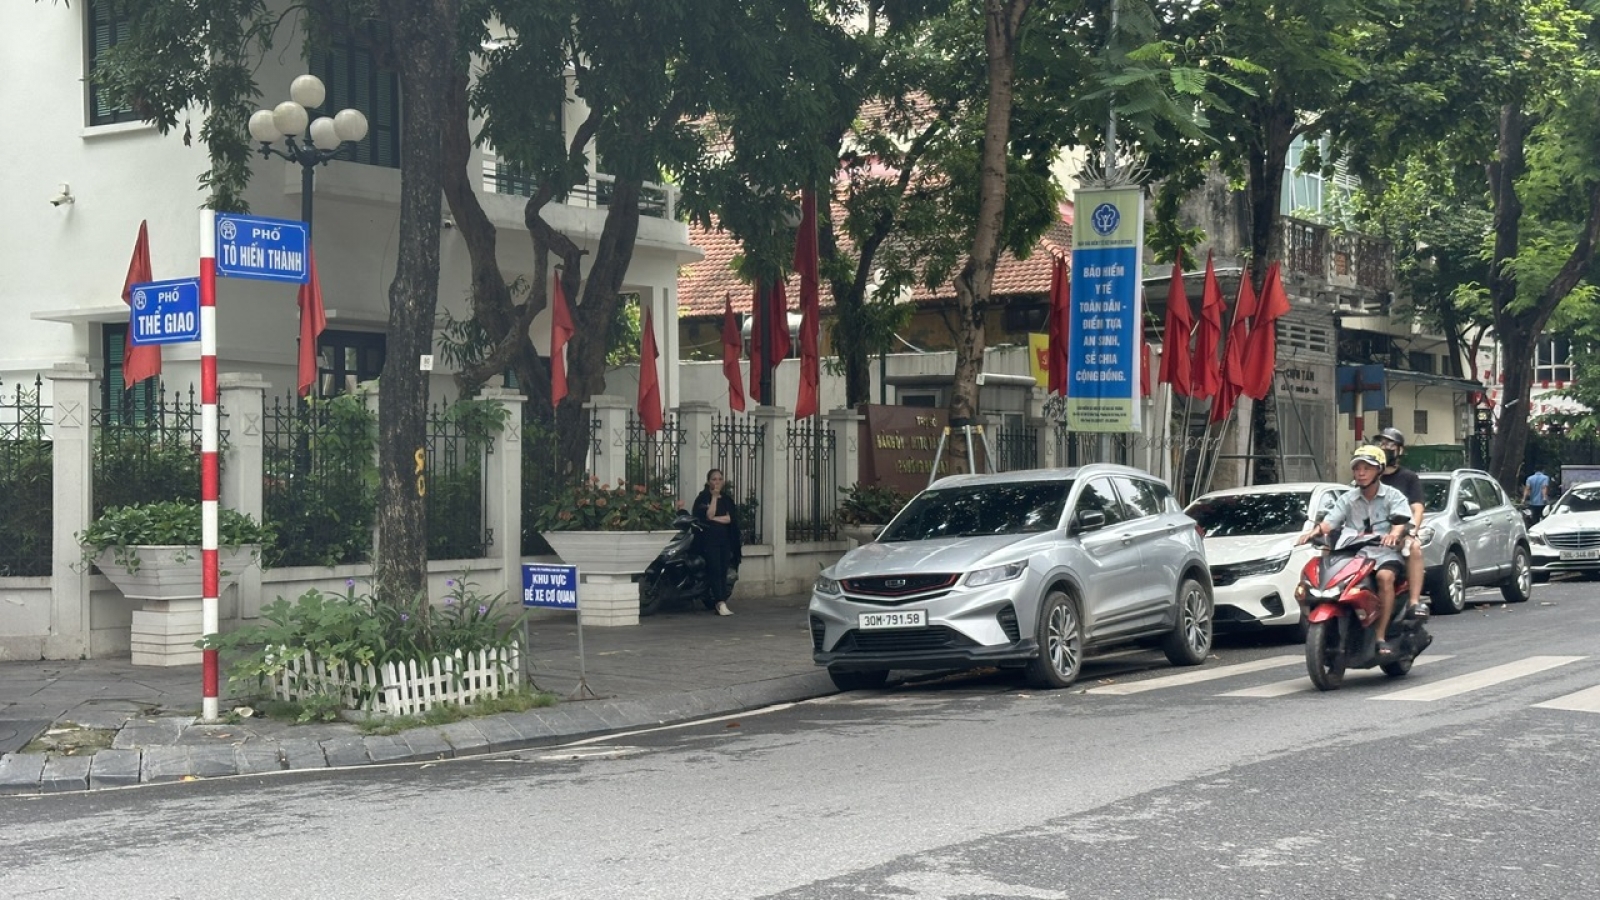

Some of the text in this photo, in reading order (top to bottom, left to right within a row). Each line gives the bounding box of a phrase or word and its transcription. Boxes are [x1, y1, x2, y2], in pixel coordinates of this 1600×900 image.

[252, 227, 281, 241] PHỐ
[223, 241, 302, 271] TÔ HIẾN THÀNH
[158, 286, 180, 303] PHỐ
[1094, 280, 1113, 295] Y TẾ
[138, 305, 195, 336] THỂ GIAO
[1084, 335, 1096, 346] AN
[1099, 354, 1117, 365] CHIA
[532, 573, 567, 587] KHU VỰC
[535, 589, 545, 602] XE
[545, 588, 556, 602] CƠ
[556, 589, 576, 604] QUAN
